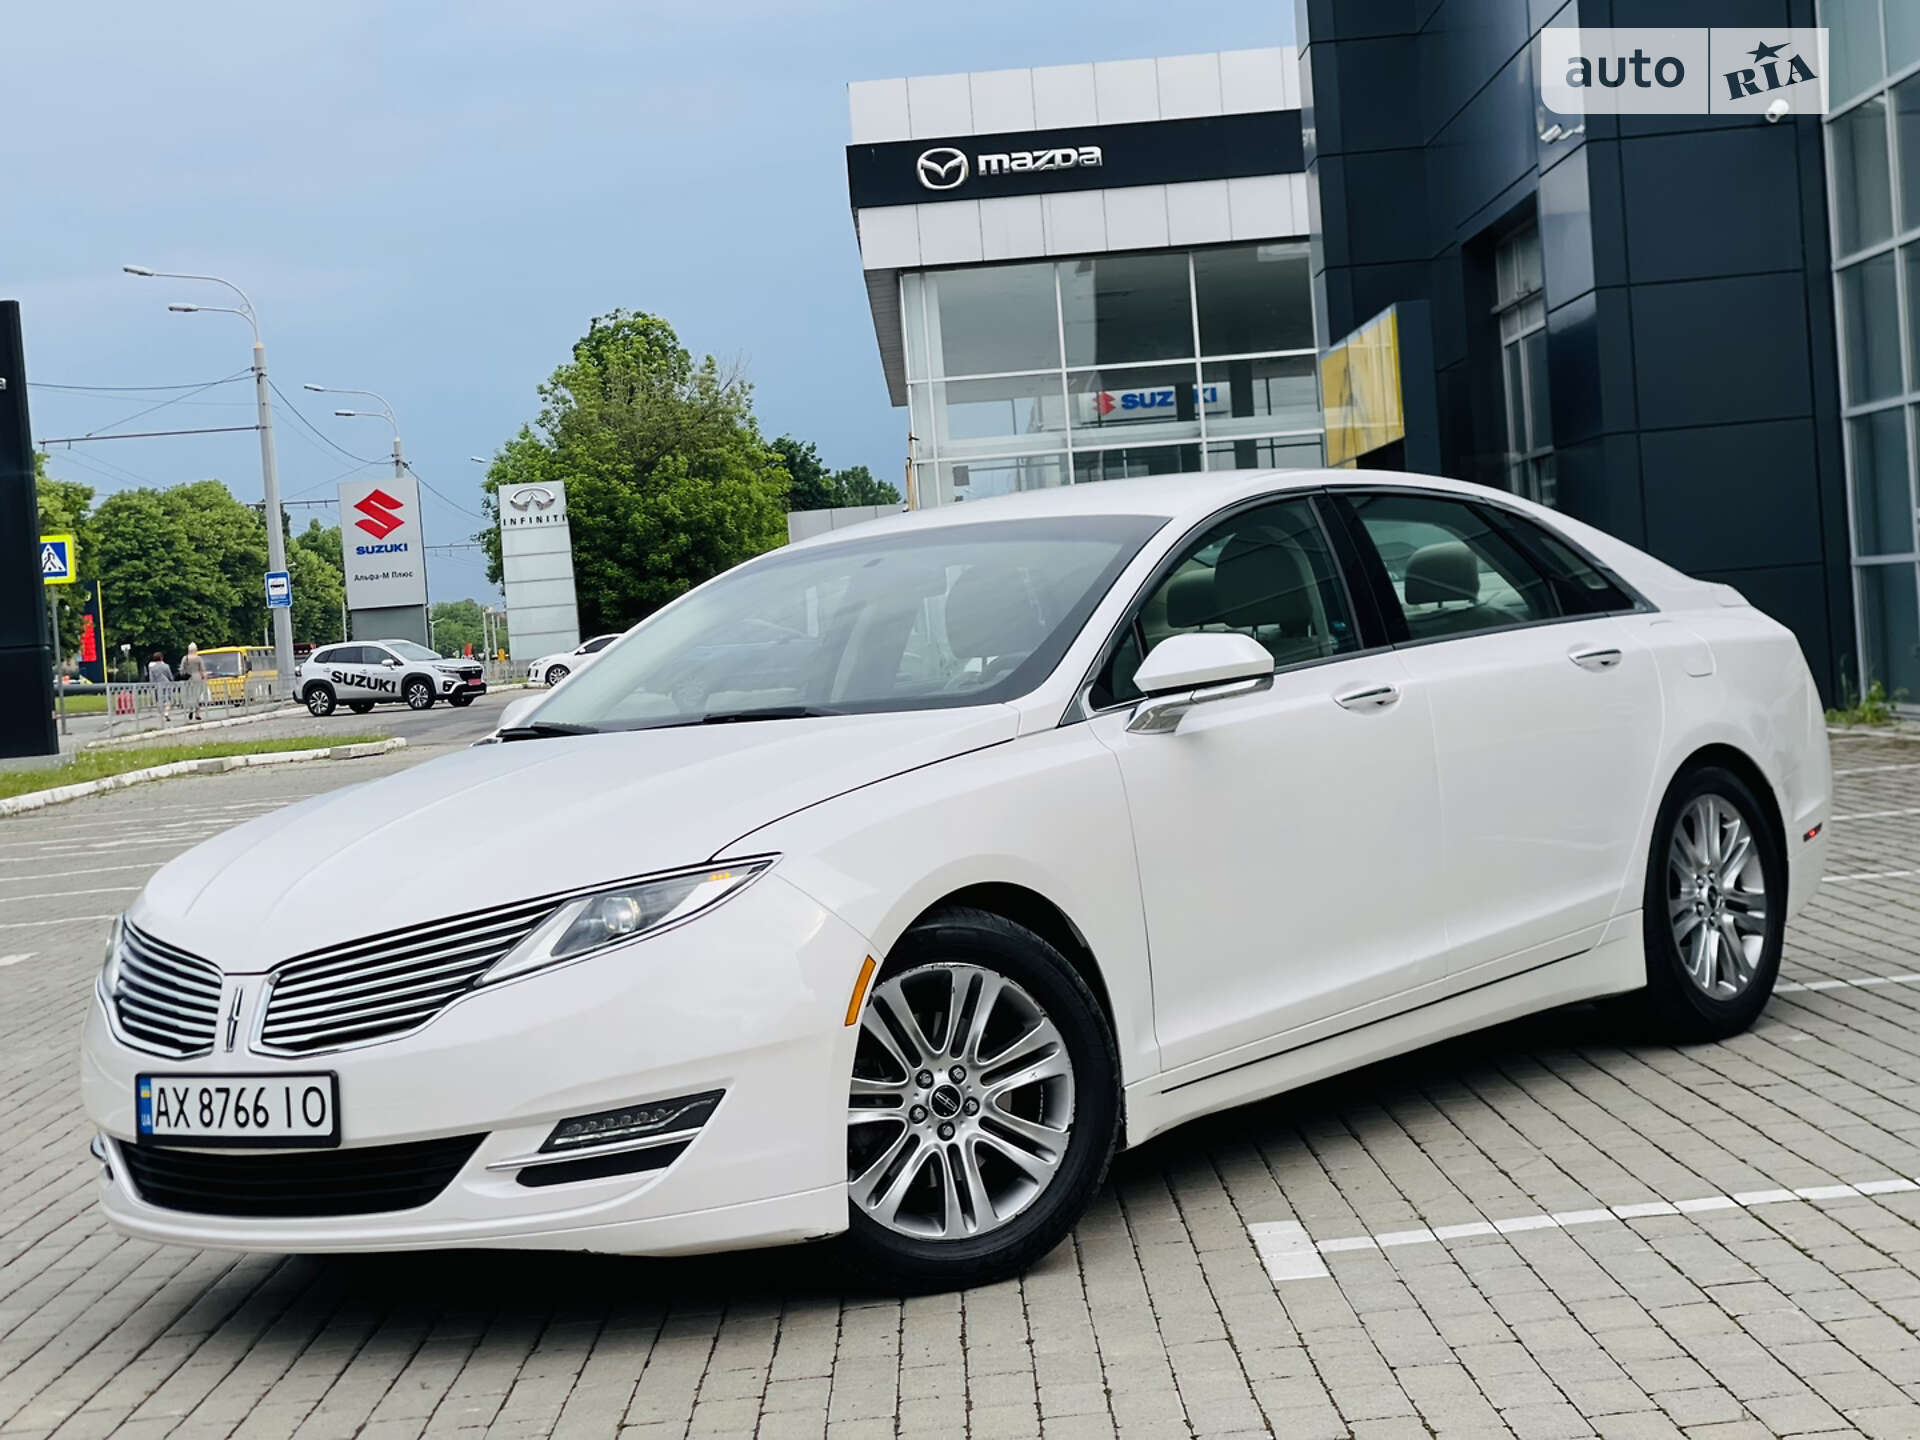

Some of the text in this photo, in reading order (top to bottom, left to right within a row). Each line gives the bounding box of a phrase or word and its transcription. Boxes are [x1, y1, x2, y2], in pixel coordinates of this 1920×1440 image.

[1121, 387, 1217, 410] SUZKI
[503, 513, 565, 526] INFINITI
[356, 543, 408, 555] SUZUKI
[331, 671, 395, 693] SUZUKI
[156, 1087, 190, 1128] AX
[199, 1087, 269, 1128] 8766
